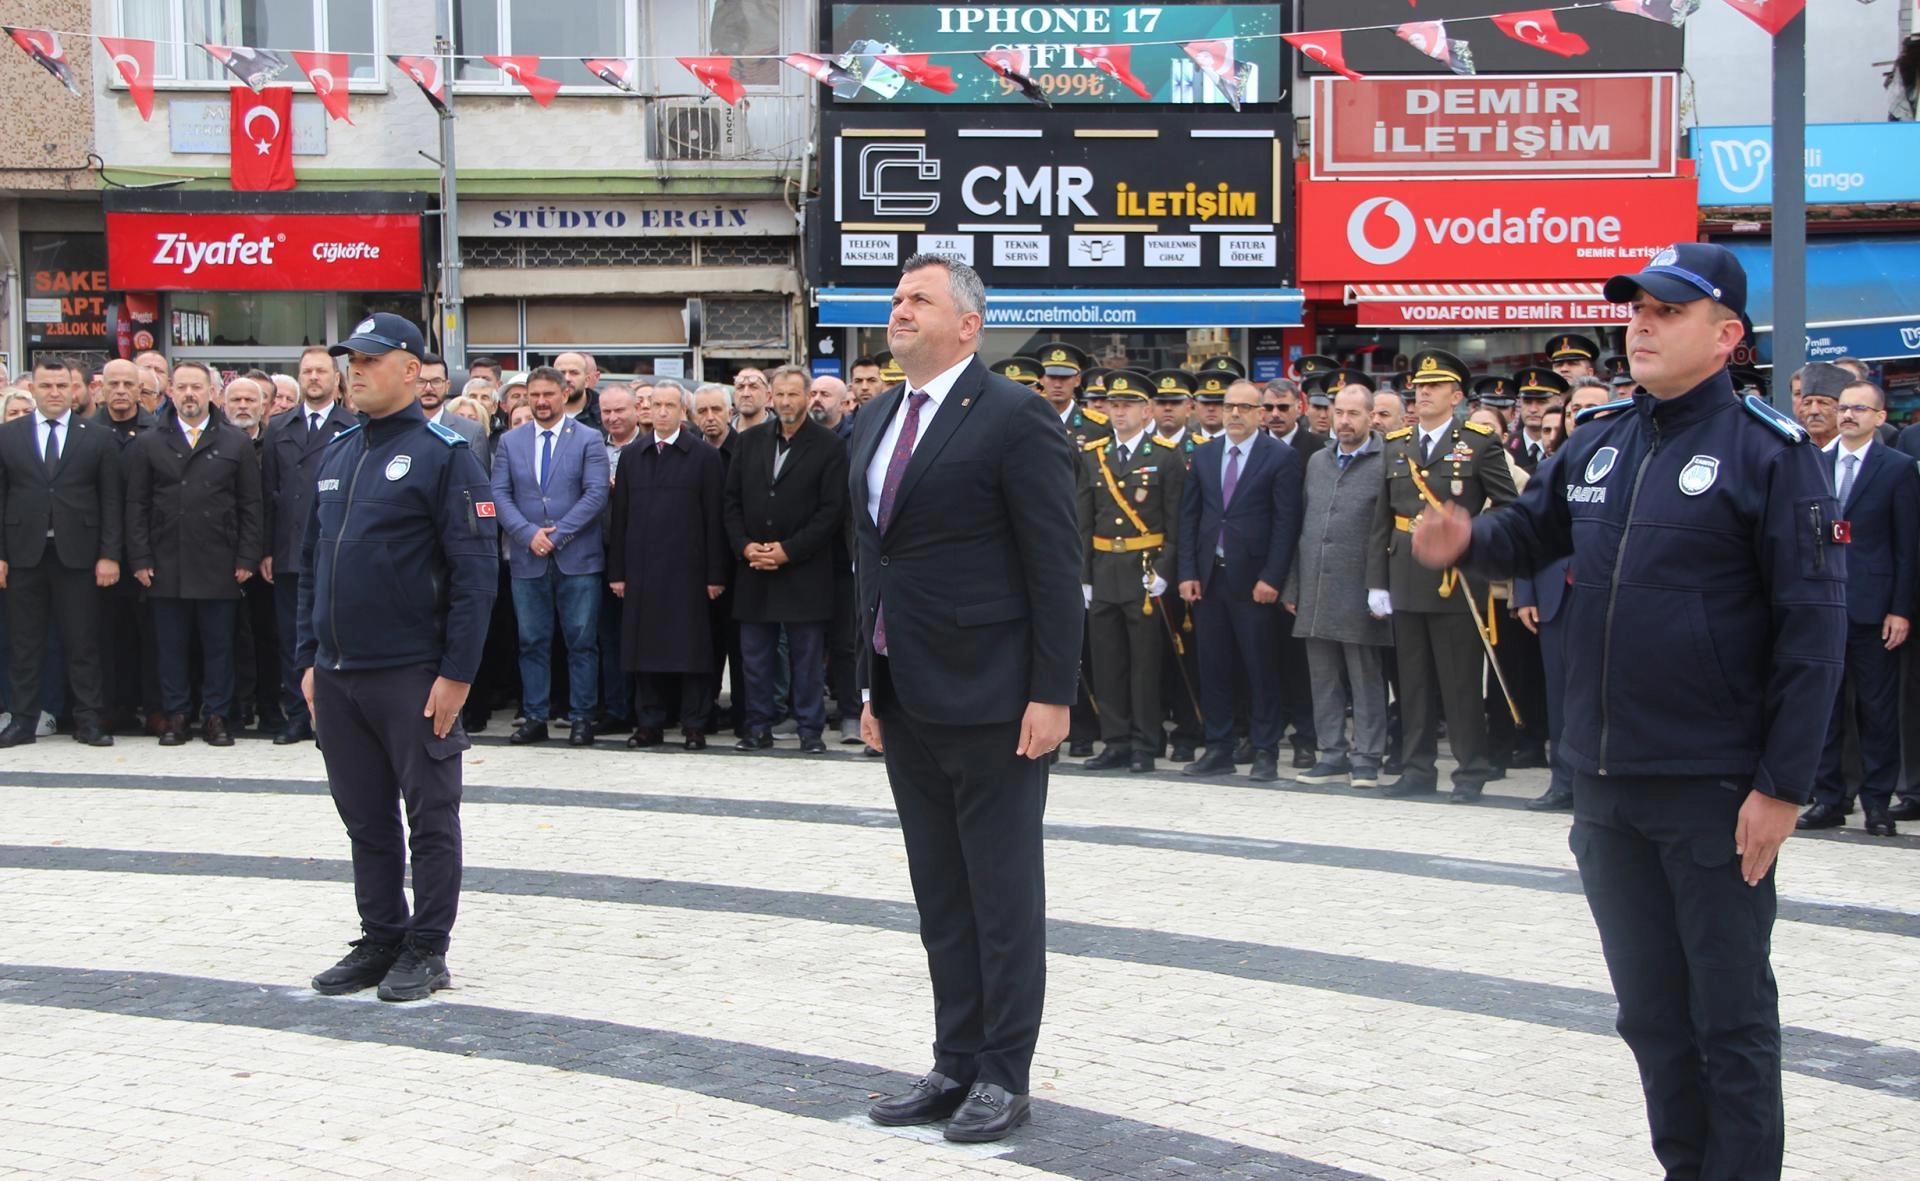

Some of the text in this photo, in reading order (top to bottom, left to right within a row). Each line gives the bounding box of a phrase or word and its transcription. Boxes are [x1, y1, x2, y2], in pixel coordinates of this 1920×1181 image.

[937, 8, 1162, 33] IPHONE 17
[1406, 82, 1580, 114] DEMİR
[1374, 120, 1610, 158] İLETİŞİM
[961, 165, 1256, 221] CMR İLETİŞİM
[493, 206, 749, 229] STÜDYO ERGİN
[1424, 208, 1621, 244] vodafone
[849, 240, 890, 249] TELEFON
[935, 240, 957, 249] 2.EL
[1229, 241, 1266, 250] FATURA
[1577, 246, 1616, 258] DEMİR
[153, 233, 381, 274] Ziyafet Çiğköfte
[844, 252, 895, 261] AKSESUAR
[1231, 252, 1265, 261] ÖDEME
[986, 306, 1136, 322] www.cnetmobil.com
[1401, 306, 1499, 320] VODAFONE
[1505, 303, 1563, 319] DEMİR
[46, 322, 89, 336] 2.BLOK
